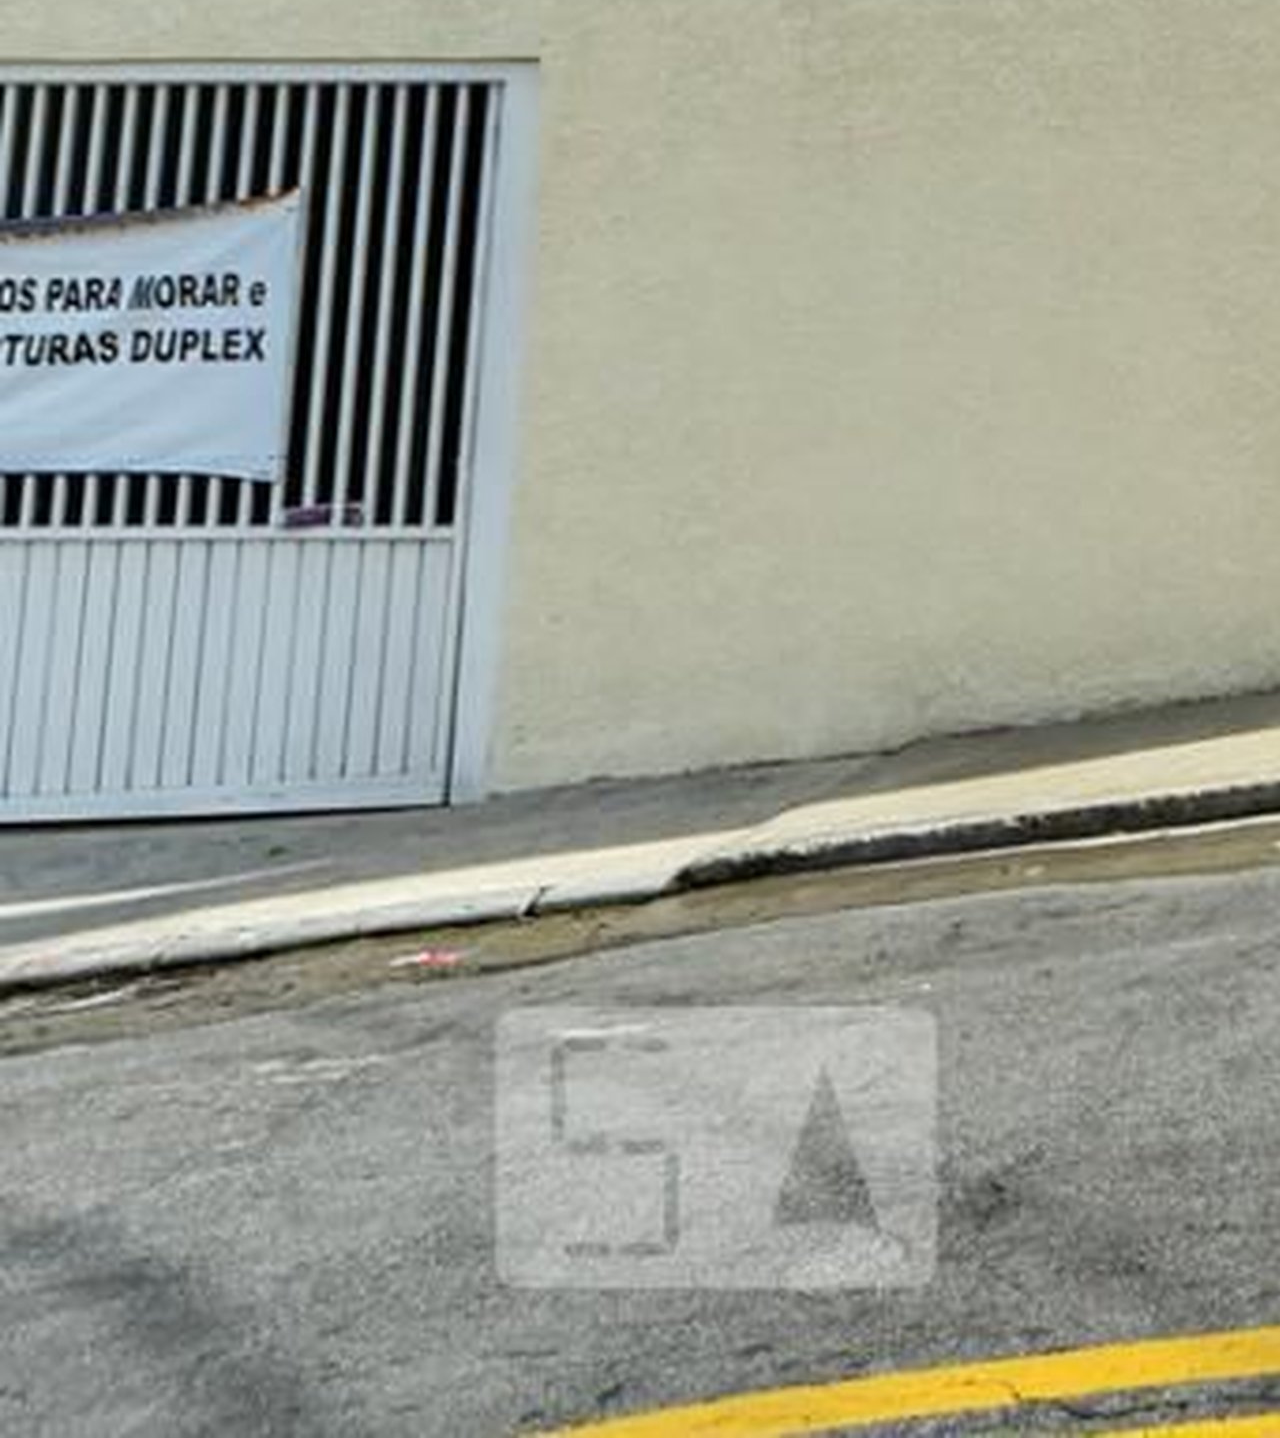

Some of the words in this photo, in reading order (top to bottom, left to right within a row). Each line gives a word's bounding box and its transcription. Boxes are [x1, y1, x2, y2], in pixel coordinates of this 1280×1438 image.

[46, 279, 121, 311] PARA
[129, 275, 239, 309] MORAR
[249, 281, 267, 307] e
[129, 329, 267, 363] DUPLEX
